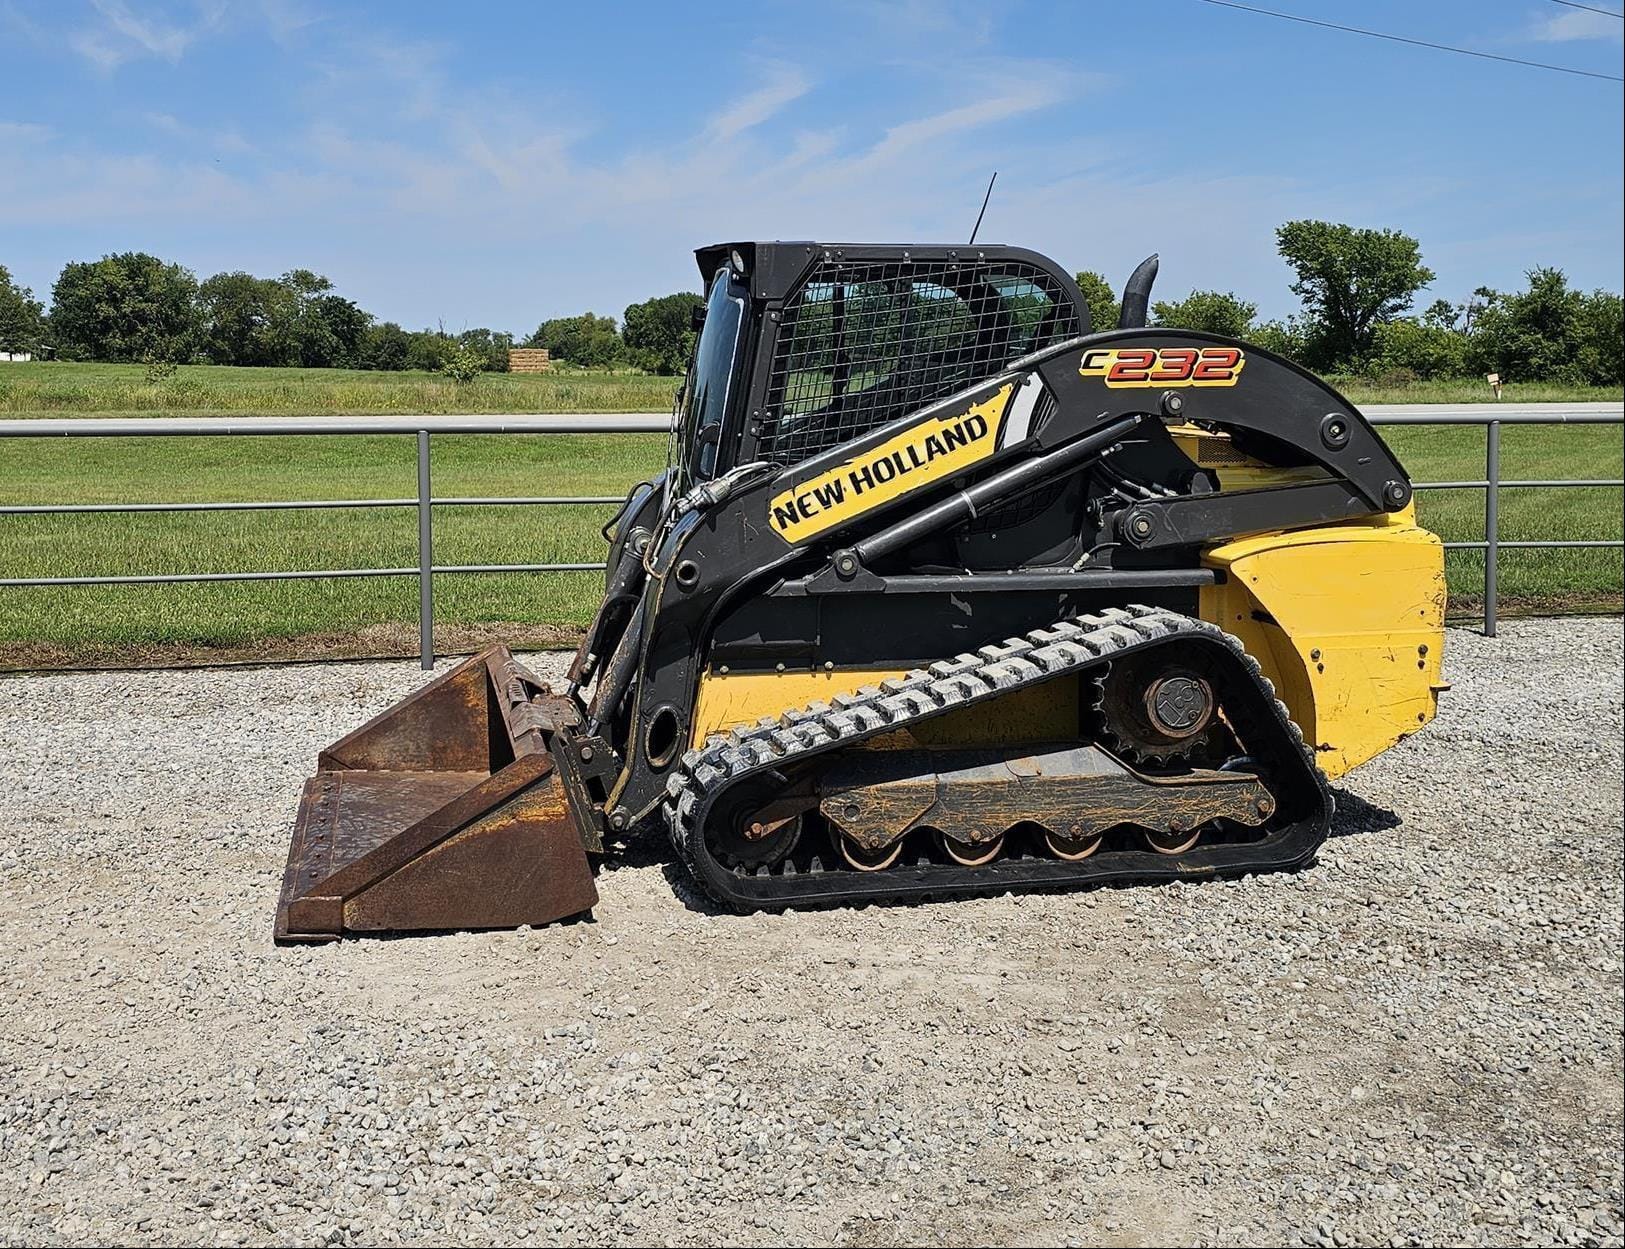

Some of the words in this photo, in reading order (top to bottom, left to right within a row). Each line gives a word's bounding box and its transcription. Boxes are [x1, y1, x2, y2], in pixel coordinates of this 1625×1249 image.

[1081, 350, 1242, 382] C232
[773, 479, 846, 529] NEW
[849, 414, 988, 495] HOLLAND
